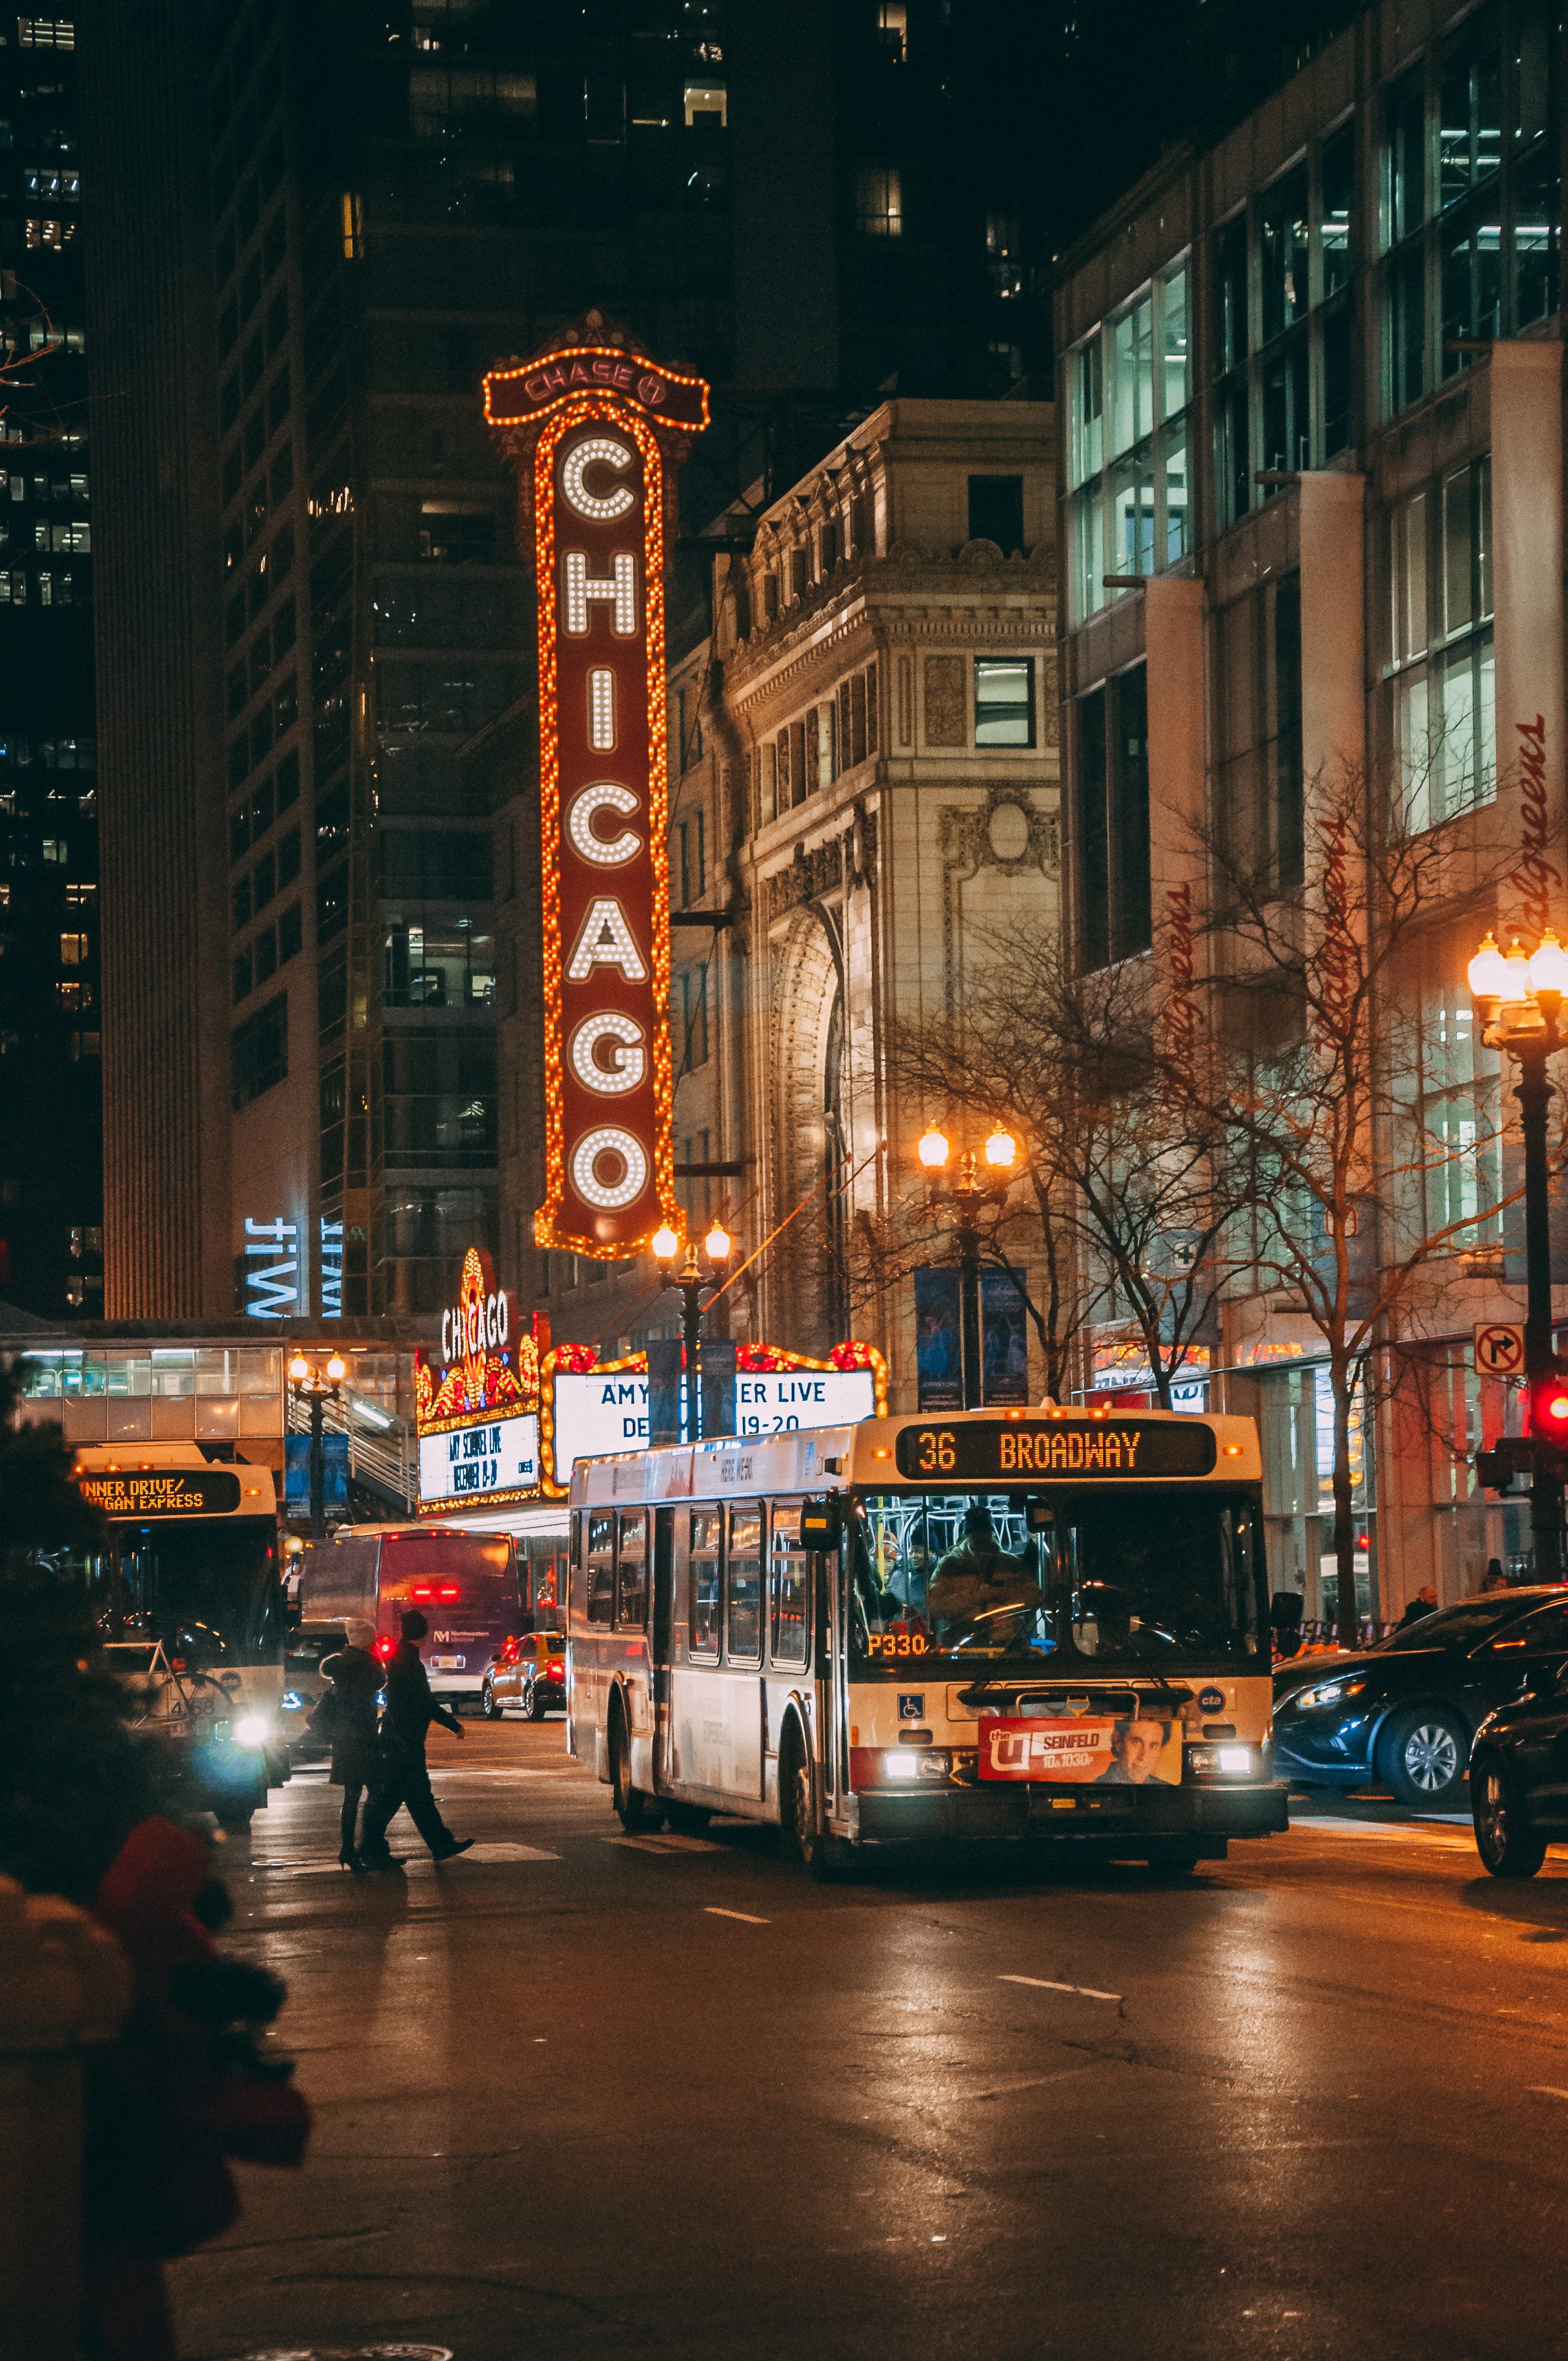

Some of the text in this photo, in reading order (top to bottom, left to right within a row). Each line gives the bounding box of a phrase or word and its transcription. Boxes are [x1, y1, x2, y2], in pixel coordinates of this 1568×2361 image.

[525, 360, 634, 401] CHASE
[563, 438, 648, 1207] CHICAGO
[442, 1289, 508, 1363] CHICAGO
[601, 1384, 649, 1405] AMY
[778, 1383, 825, 1402] LIVE
[742, 1415, 799, 1435] 19-20
[919, 1432, 1140, 1469] 36 BROADWAY
[130, 1478, 184, 1496] DRIVE/
[140, 1493, 204, 1509] EXPRESS
[868, 1635, 925, 1656] P330
[1202, 1696, 1221, 1705] cta
[991, 1730, 1011, 1740] the
[1043, 1733, 1099, 1750] SEINFELD
